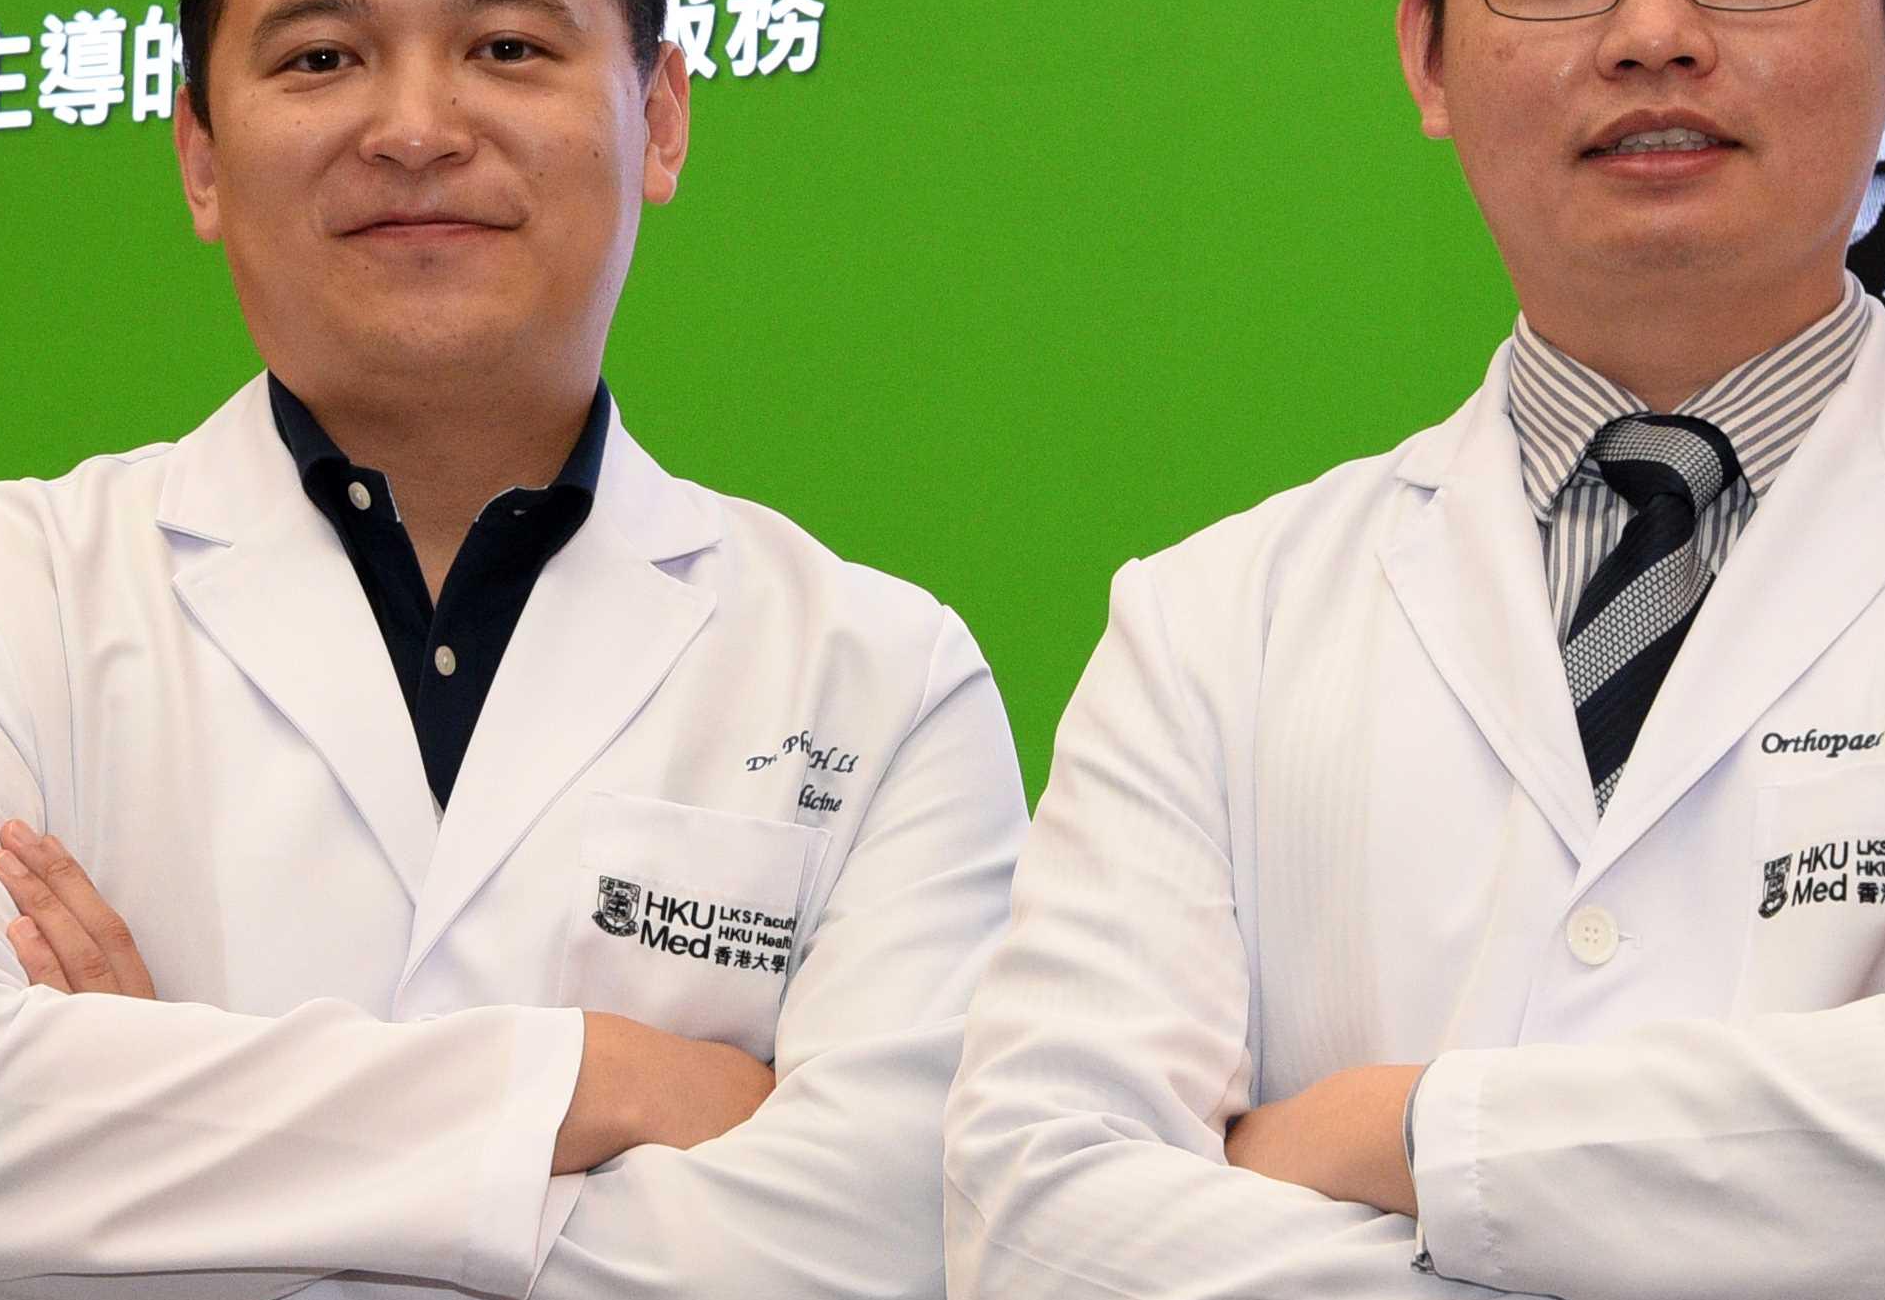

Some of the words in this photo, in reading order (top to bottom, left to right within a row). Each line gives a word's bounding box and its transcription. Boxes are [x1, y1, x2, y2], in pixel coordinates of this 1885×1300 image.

[1797, 841, 1849, 876] HKU
[1791, 873, 1848, 906] Med
[644, 891, 716, 930] HKU
[719, 906, 752, 924] LKS
[640, 920, 711, 959] Med
[718, 925, 753, 944] HKU
